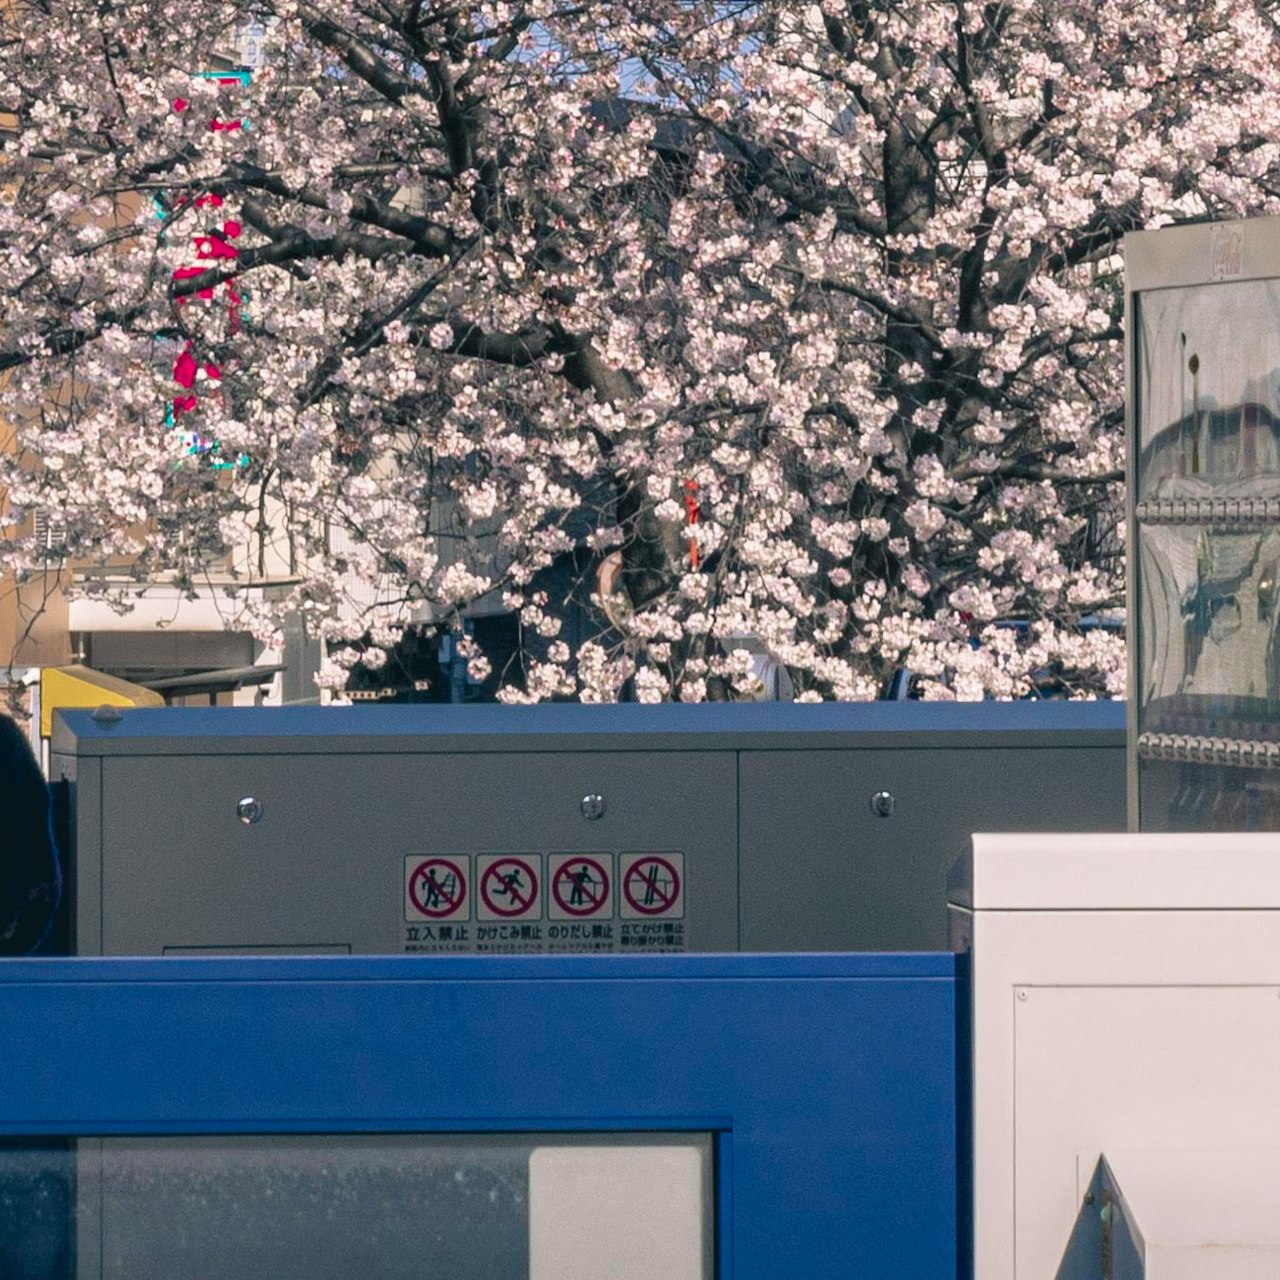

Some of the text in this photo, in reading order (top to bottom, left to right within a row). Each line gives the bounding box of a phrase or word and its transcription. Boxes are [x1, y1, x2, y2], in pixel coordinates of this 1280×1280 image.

[406, 925, 469, 941] 立入禁止
[476, 925, 543, 940] かけこみ禁止
[548, 924, 614, 939] のりだし禁止
